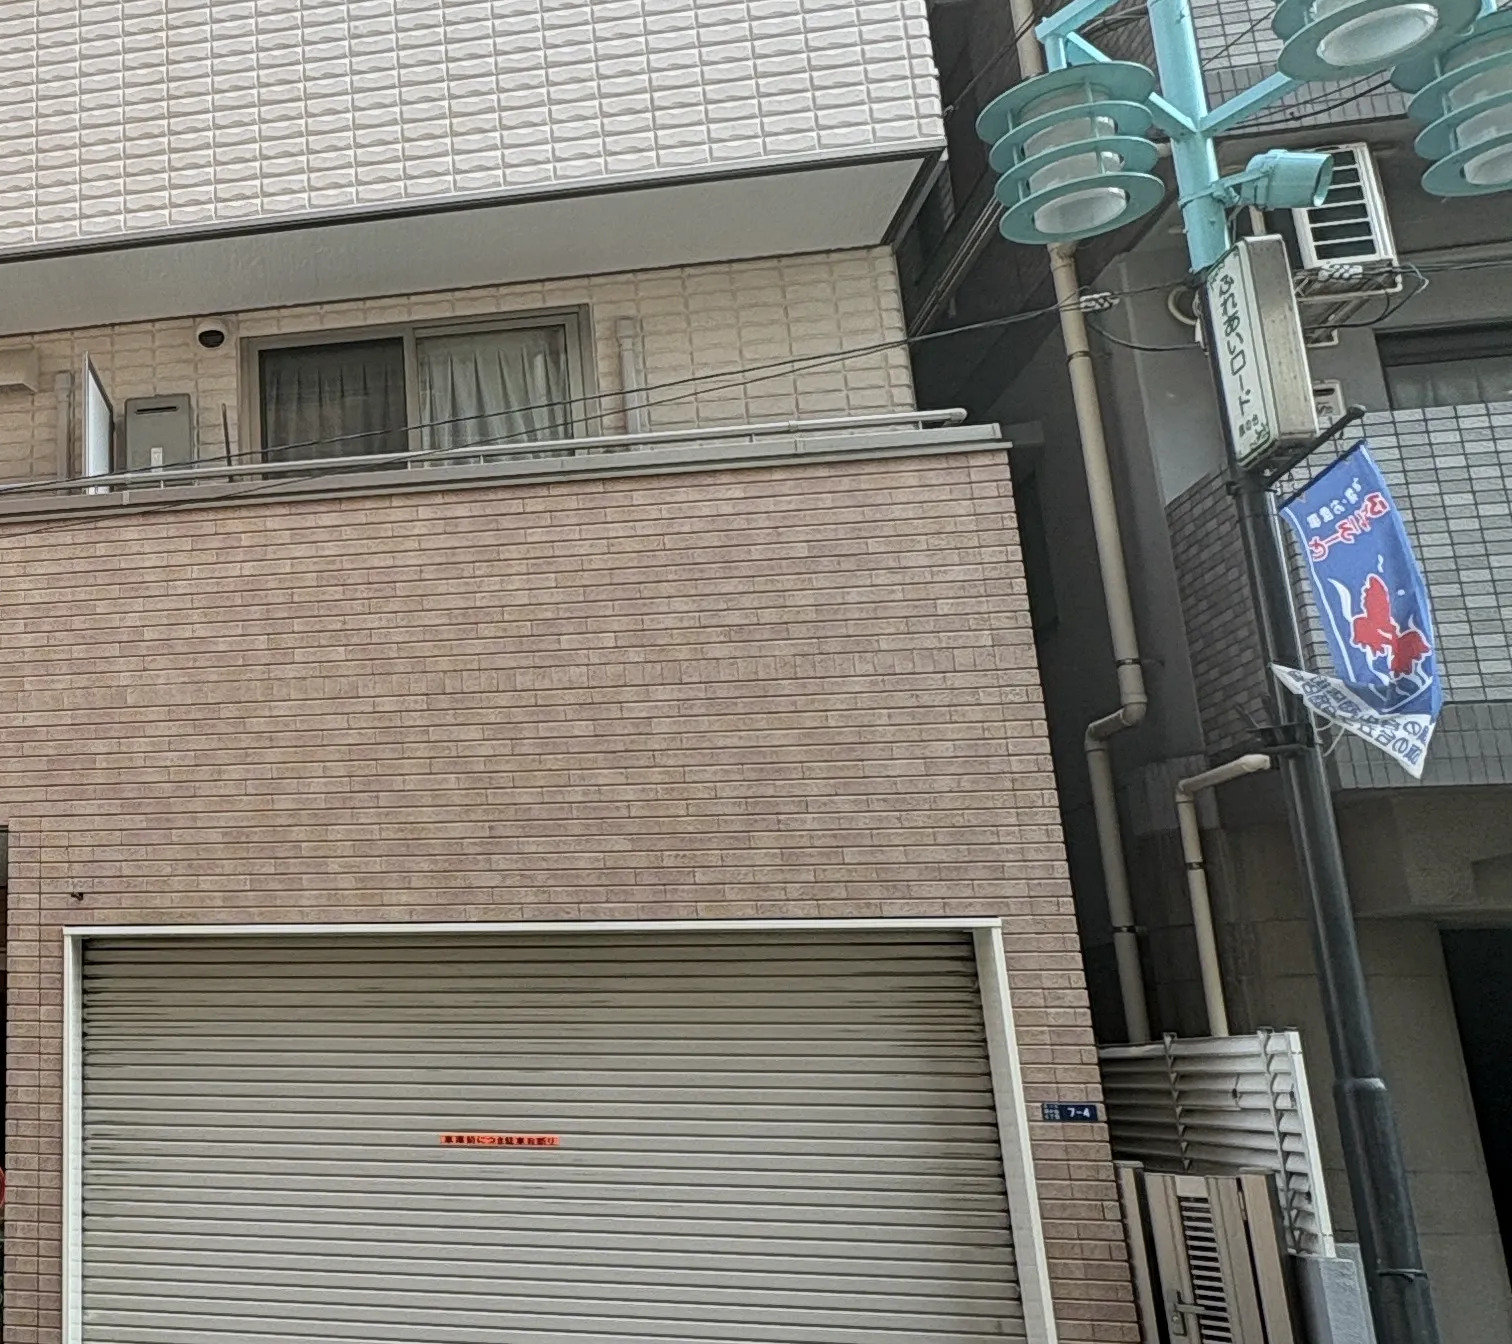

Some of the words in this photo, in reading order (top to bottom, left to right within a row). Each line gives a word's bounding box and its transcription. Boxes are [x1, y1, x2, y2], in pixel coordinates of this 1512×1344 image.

[1219, 273, 1251, 416] ふれあいロード
[1067, 1107, 1091, 1118] 7-4
